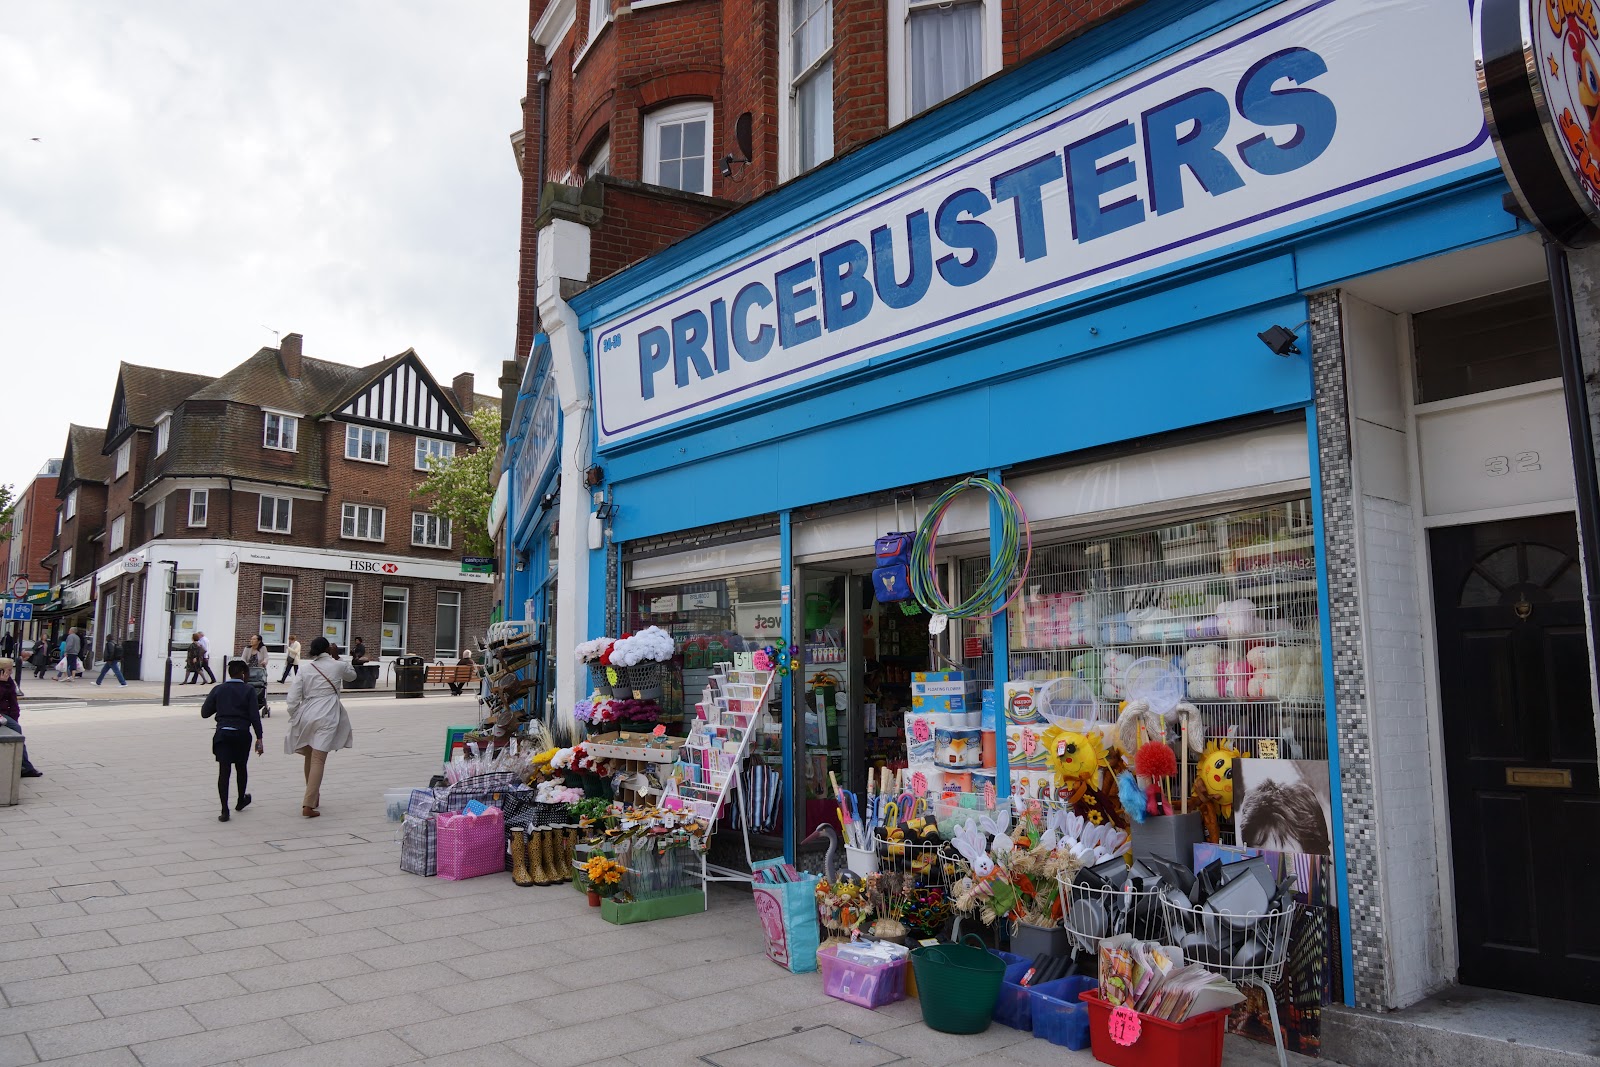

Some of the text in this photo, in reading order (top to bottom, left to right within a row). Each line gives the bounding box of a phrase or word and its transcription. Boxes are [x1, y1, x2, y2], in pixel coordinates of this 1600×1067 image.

[638, 46, 1337, 400] PRICEBUSTERS
[1485, 451, 1541, 477] 32
[349, 560, 381, 573] HSBC
[26, 591, 50, 601] SUBWAY
